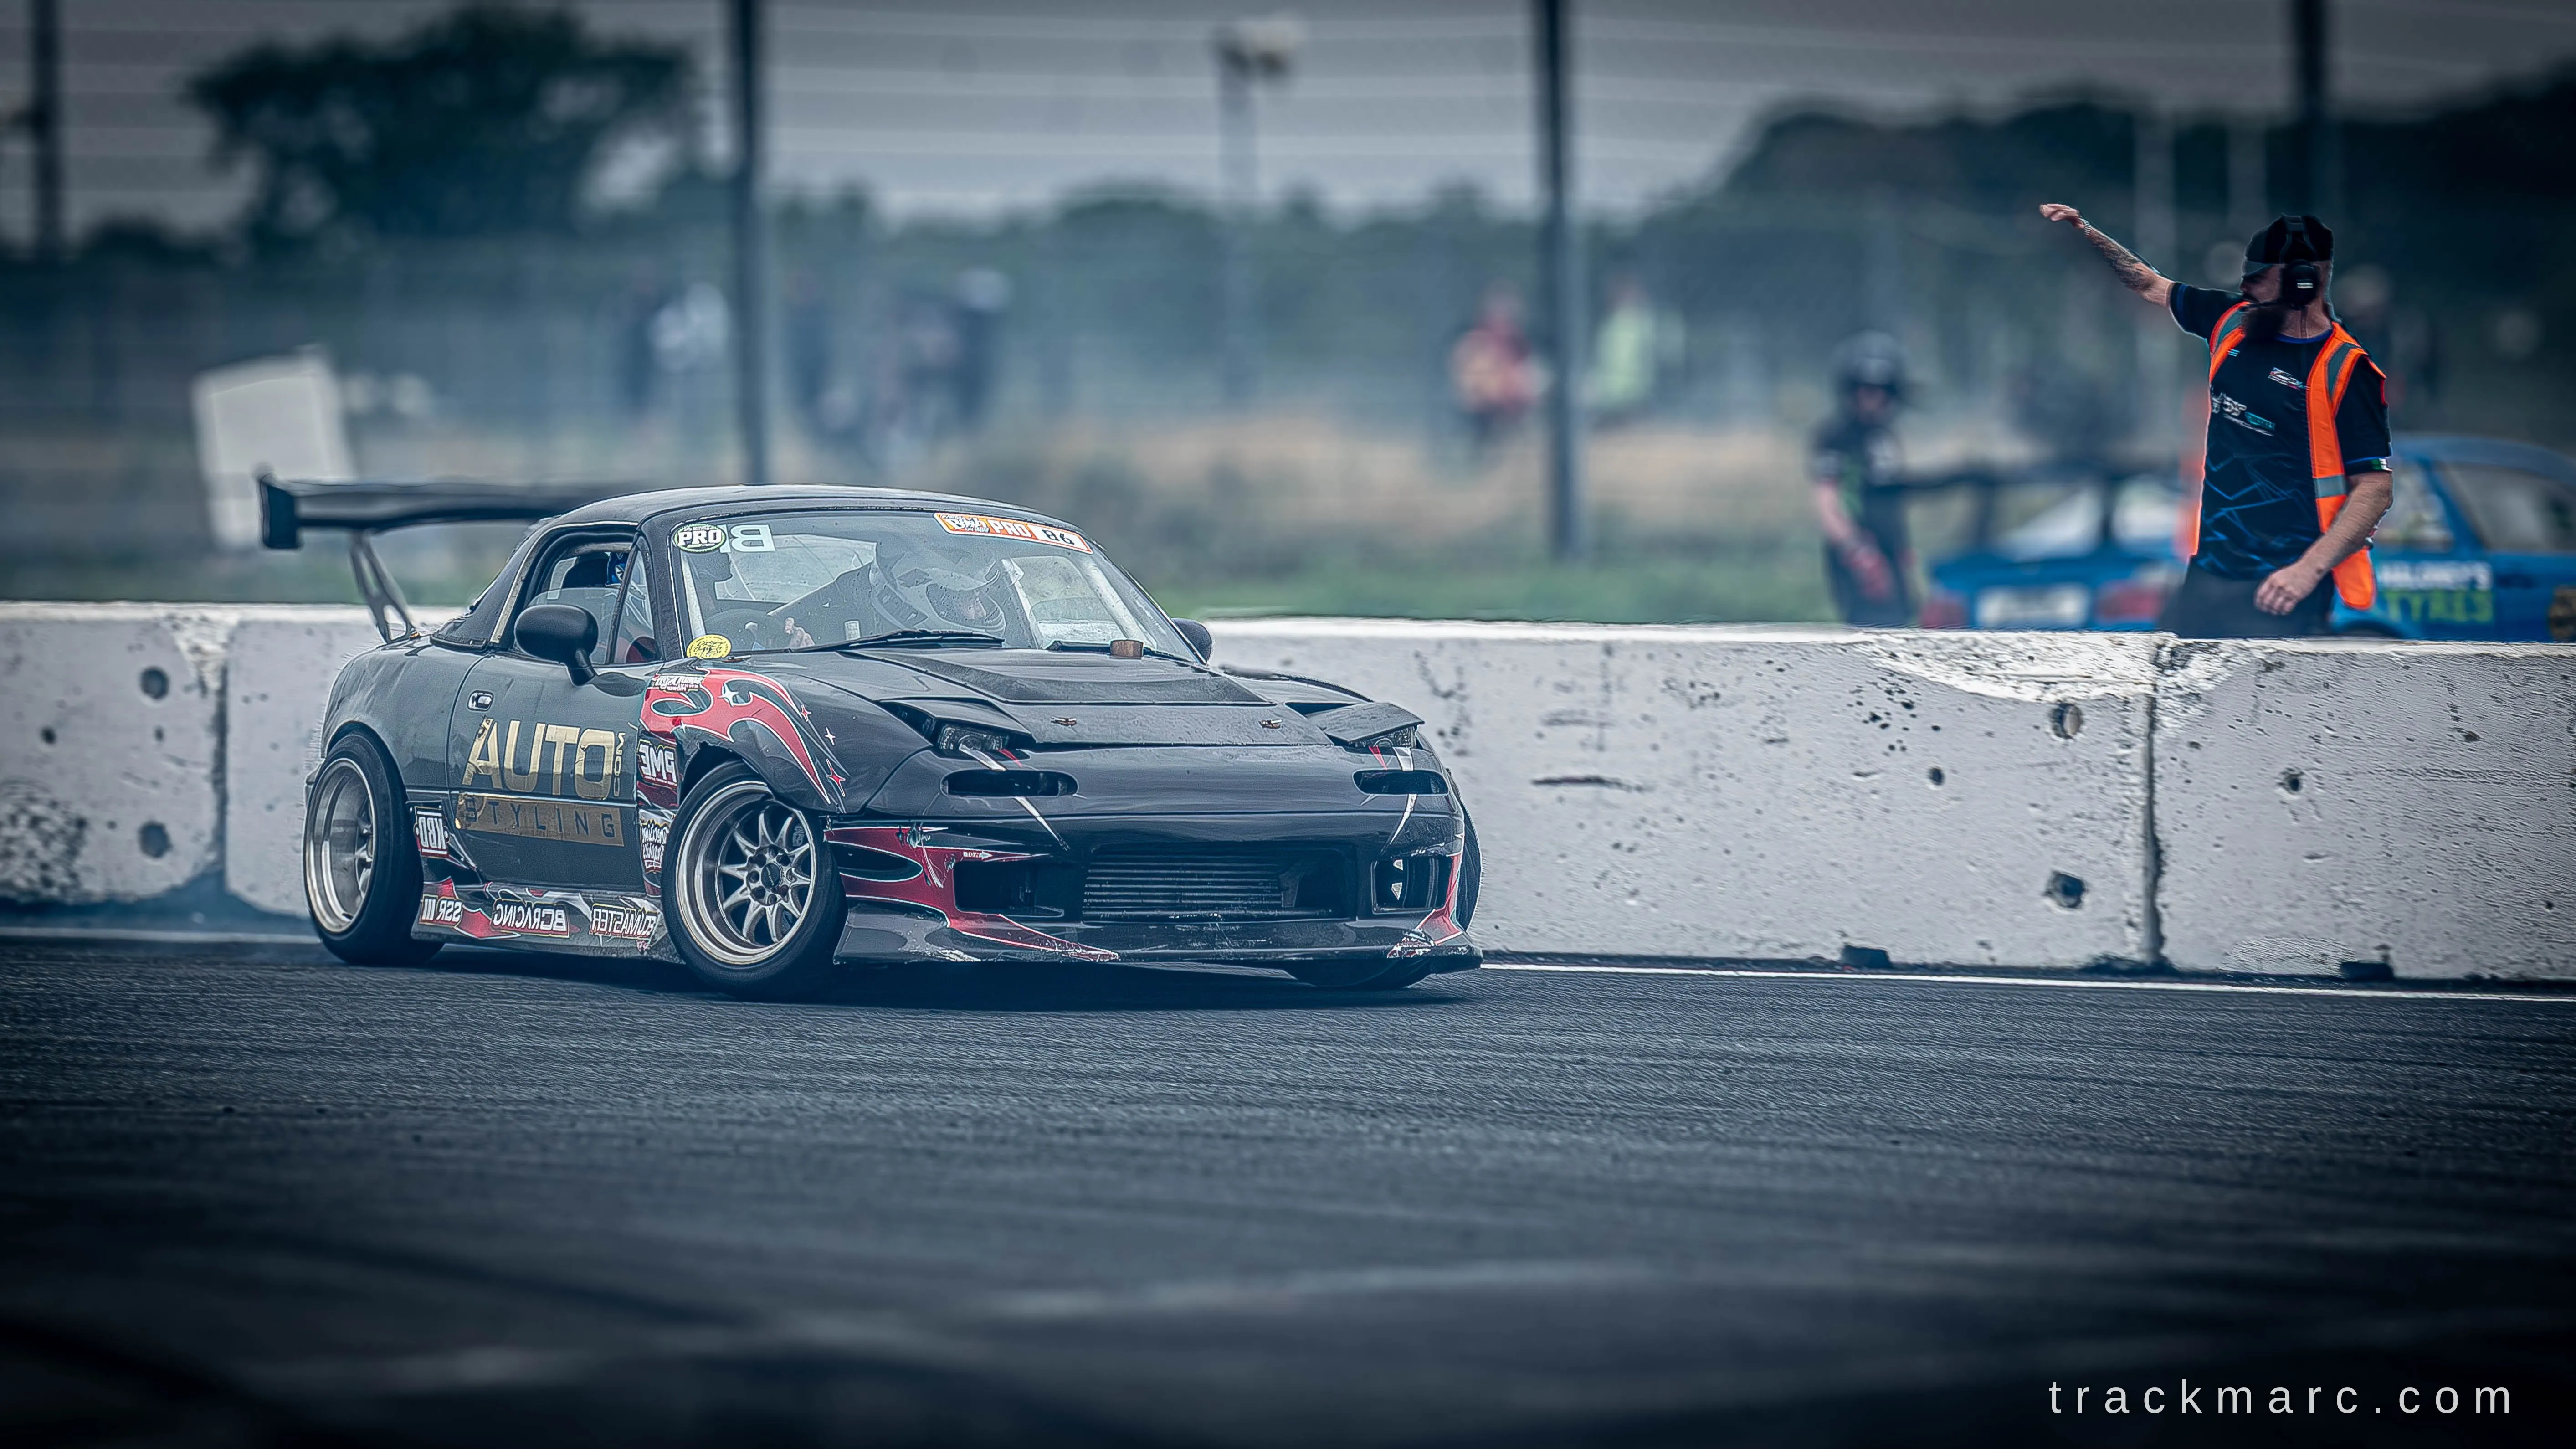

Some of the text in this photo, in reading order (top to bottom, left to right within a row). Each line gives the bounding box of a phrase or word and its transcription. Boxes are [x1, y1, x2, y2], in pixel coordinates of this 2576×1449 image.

[677, 529, 722, 546] PRO
[988, 519, 1032, 538] PRO
[1042, 529, 1074, 545] 86
[2385, 590, 2494, 622] TYRES
[462, 717, 615, 800] AUTO
[465, 797, 615, 838] STYLING
